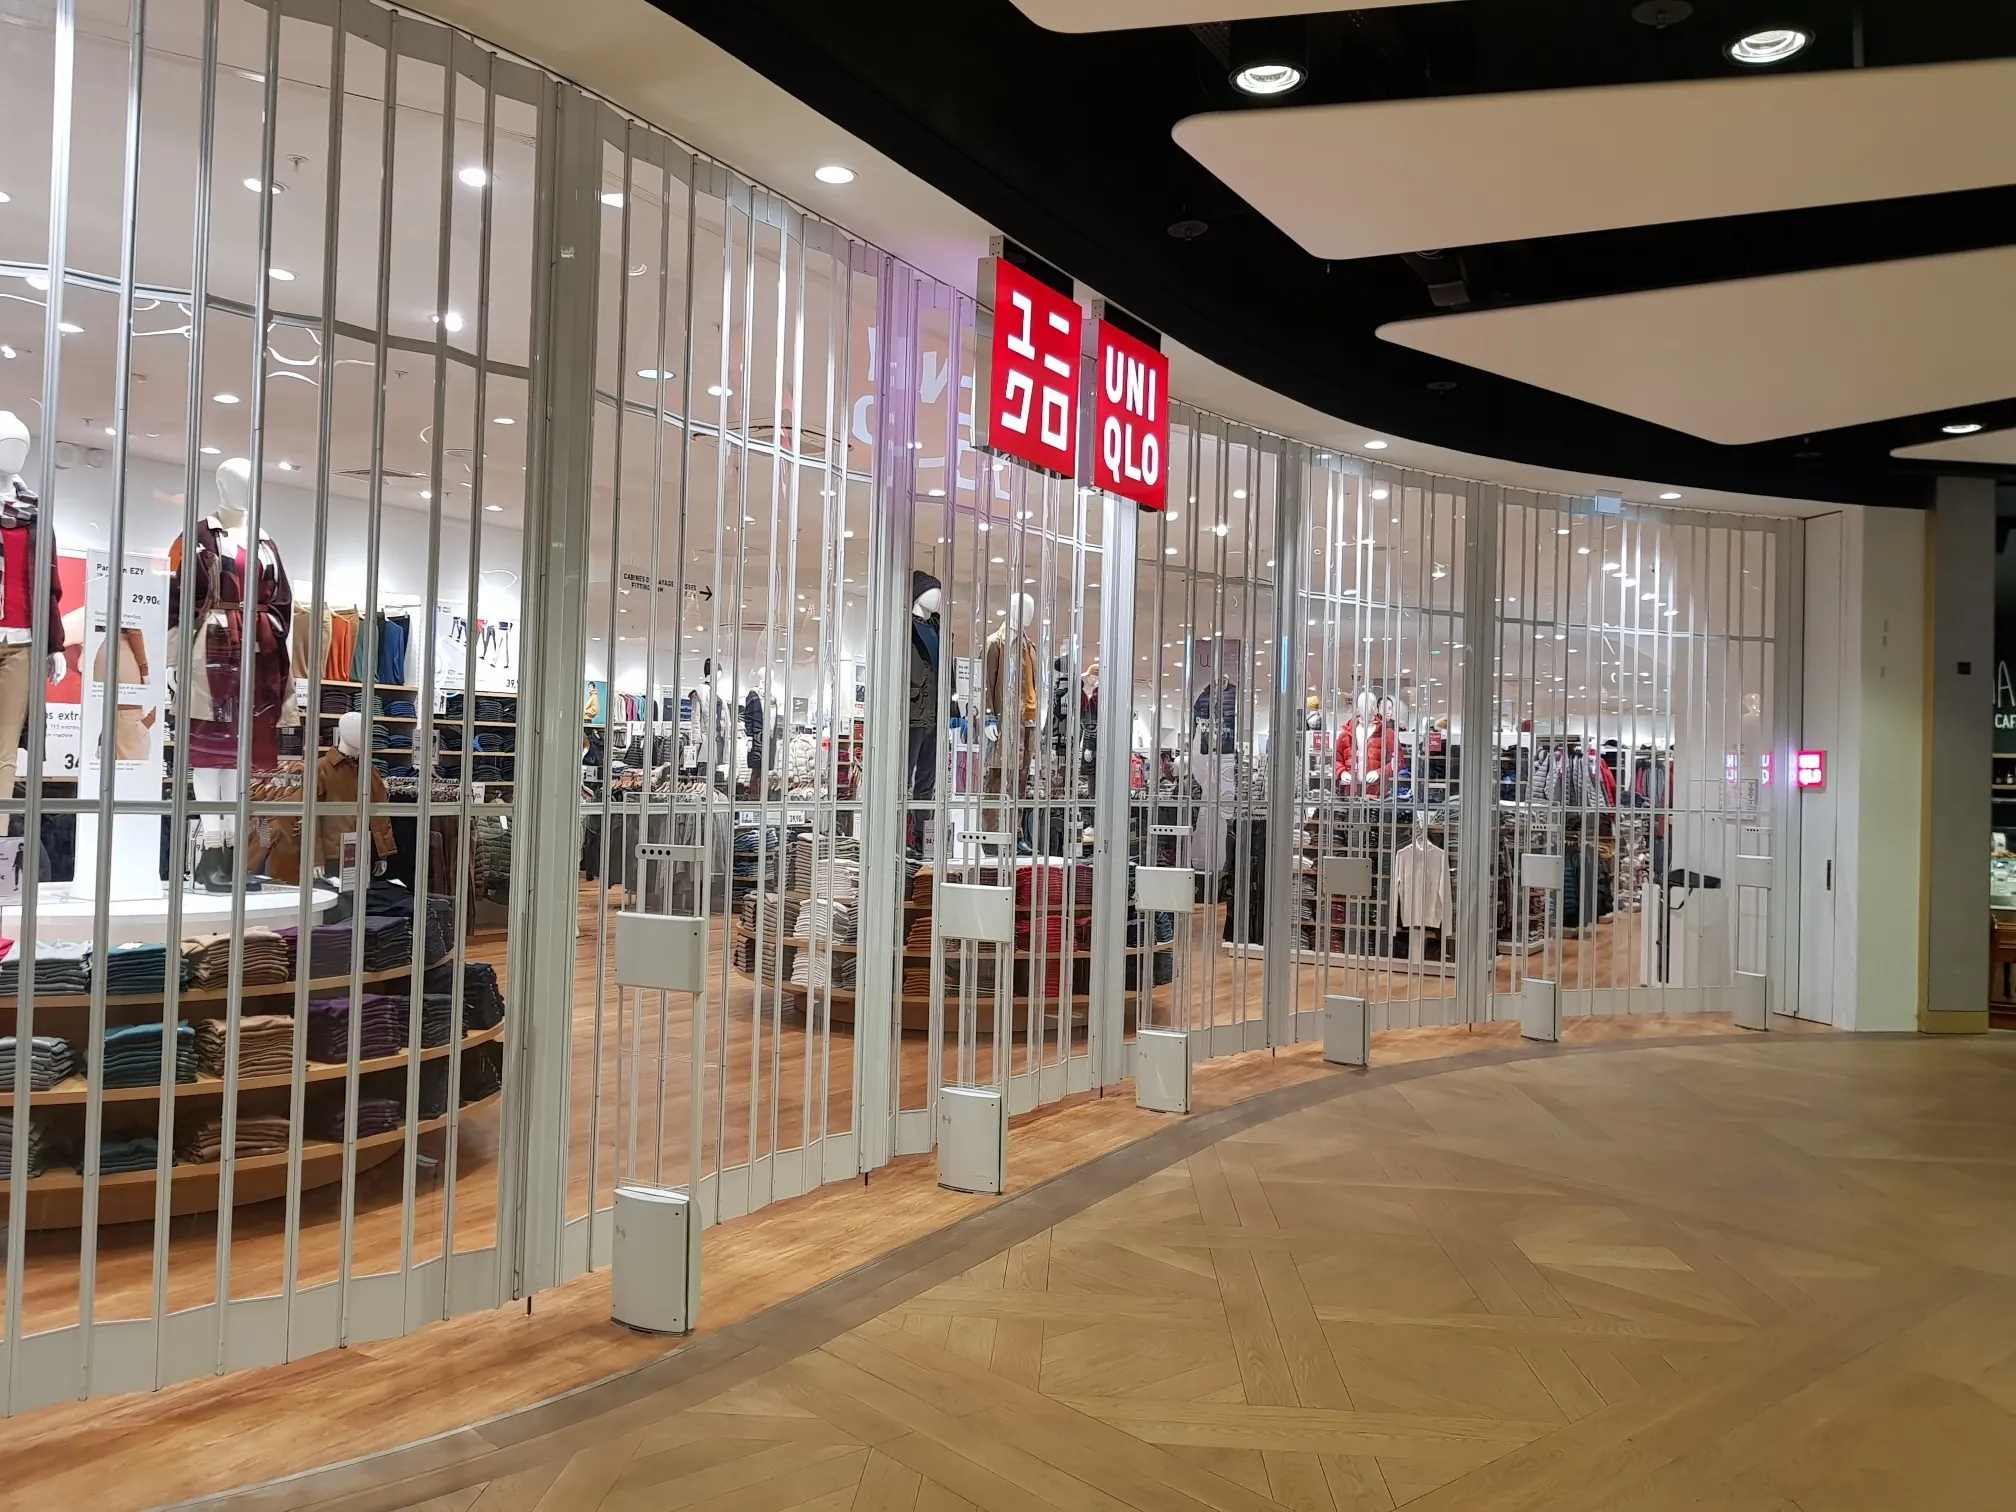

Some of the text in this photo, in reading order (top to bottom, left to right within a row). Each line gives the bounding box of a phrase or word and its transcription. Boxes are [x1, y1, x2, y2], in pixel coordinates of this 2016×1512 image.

[1007, 290, 1070, 379] ユニ
[1001, 368, 1069, 452] クロ
[1104, 344, 1157, 422] UNI
[1102, 416, 1160, 486] QLO
[130, 567, 145, 576] EZY
[623, 573, 645, 582] CABINES
[58, 709, 82, 721] extr
